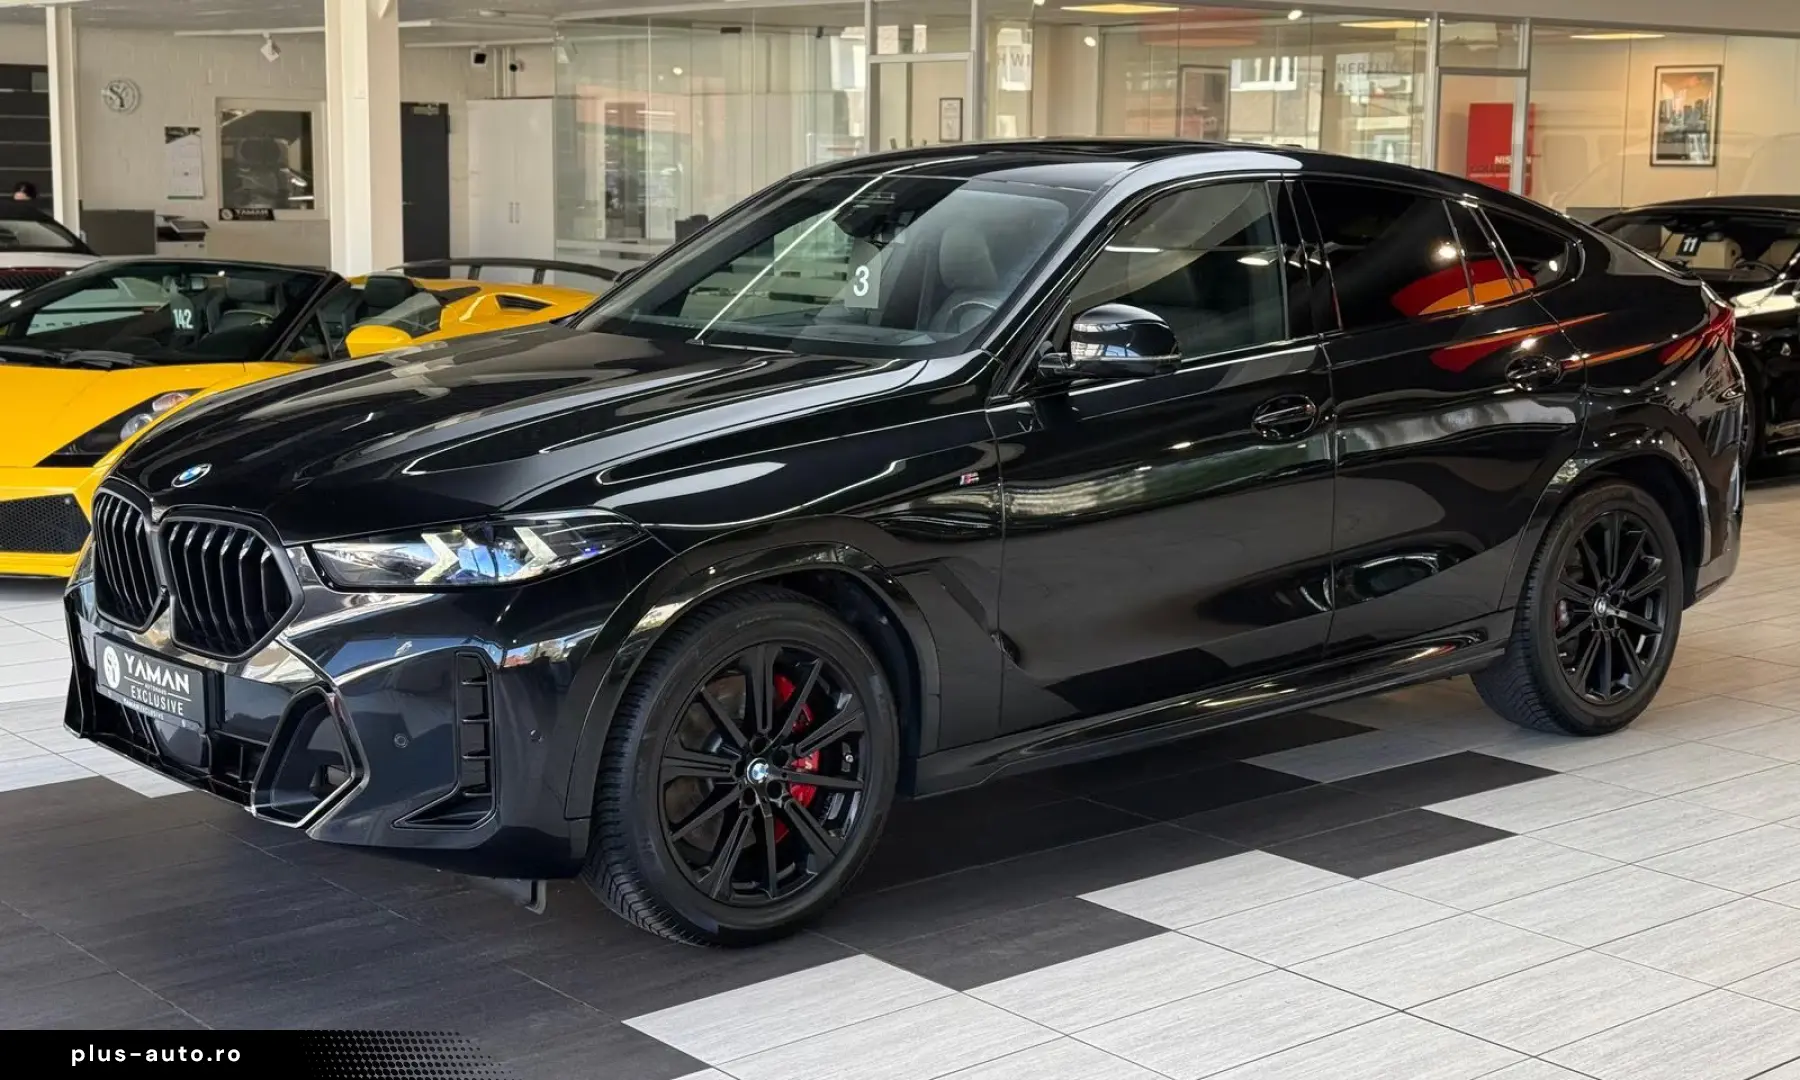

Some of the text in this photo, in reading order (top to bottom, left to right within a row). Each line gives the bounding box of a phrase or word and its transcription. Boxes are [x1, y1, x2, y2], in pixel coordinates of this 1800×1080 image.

[1494, 155, 1532, 165] NISN
[1683, 237, 1698, 252] 11
[853, 265, 869, 297] 3
[173, 309, 194, 329] 142
[124, 652, 190, 694] YAMAN
[131, 685, 184, 716] EXCLUSIVE
